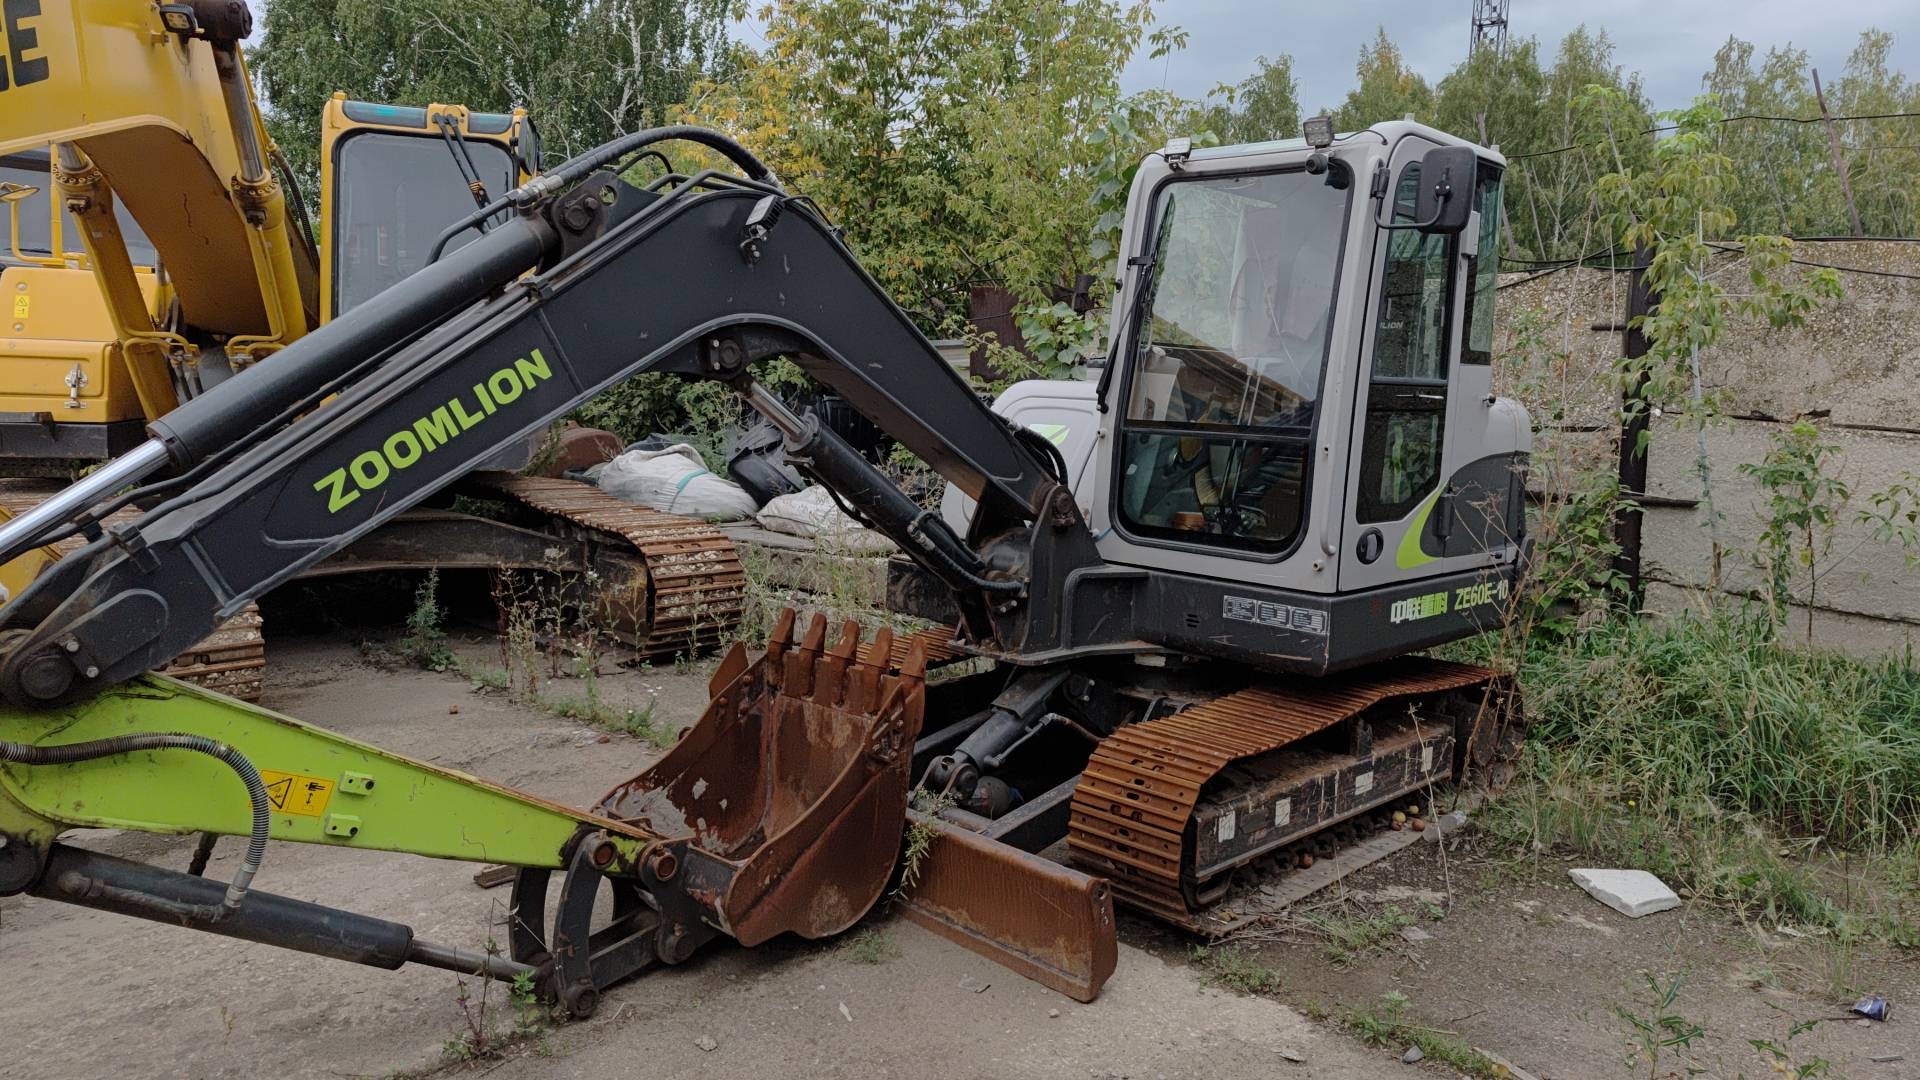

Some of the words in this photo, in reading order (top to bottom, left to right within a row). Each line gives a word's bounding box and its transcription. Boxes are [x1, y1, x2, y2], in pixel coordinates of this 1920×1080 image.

[0, 0, 50, 92] E
[313, 348, 552, 513] ZOOMLION
[1454, 579, 1509, 611] ZE60E-10
